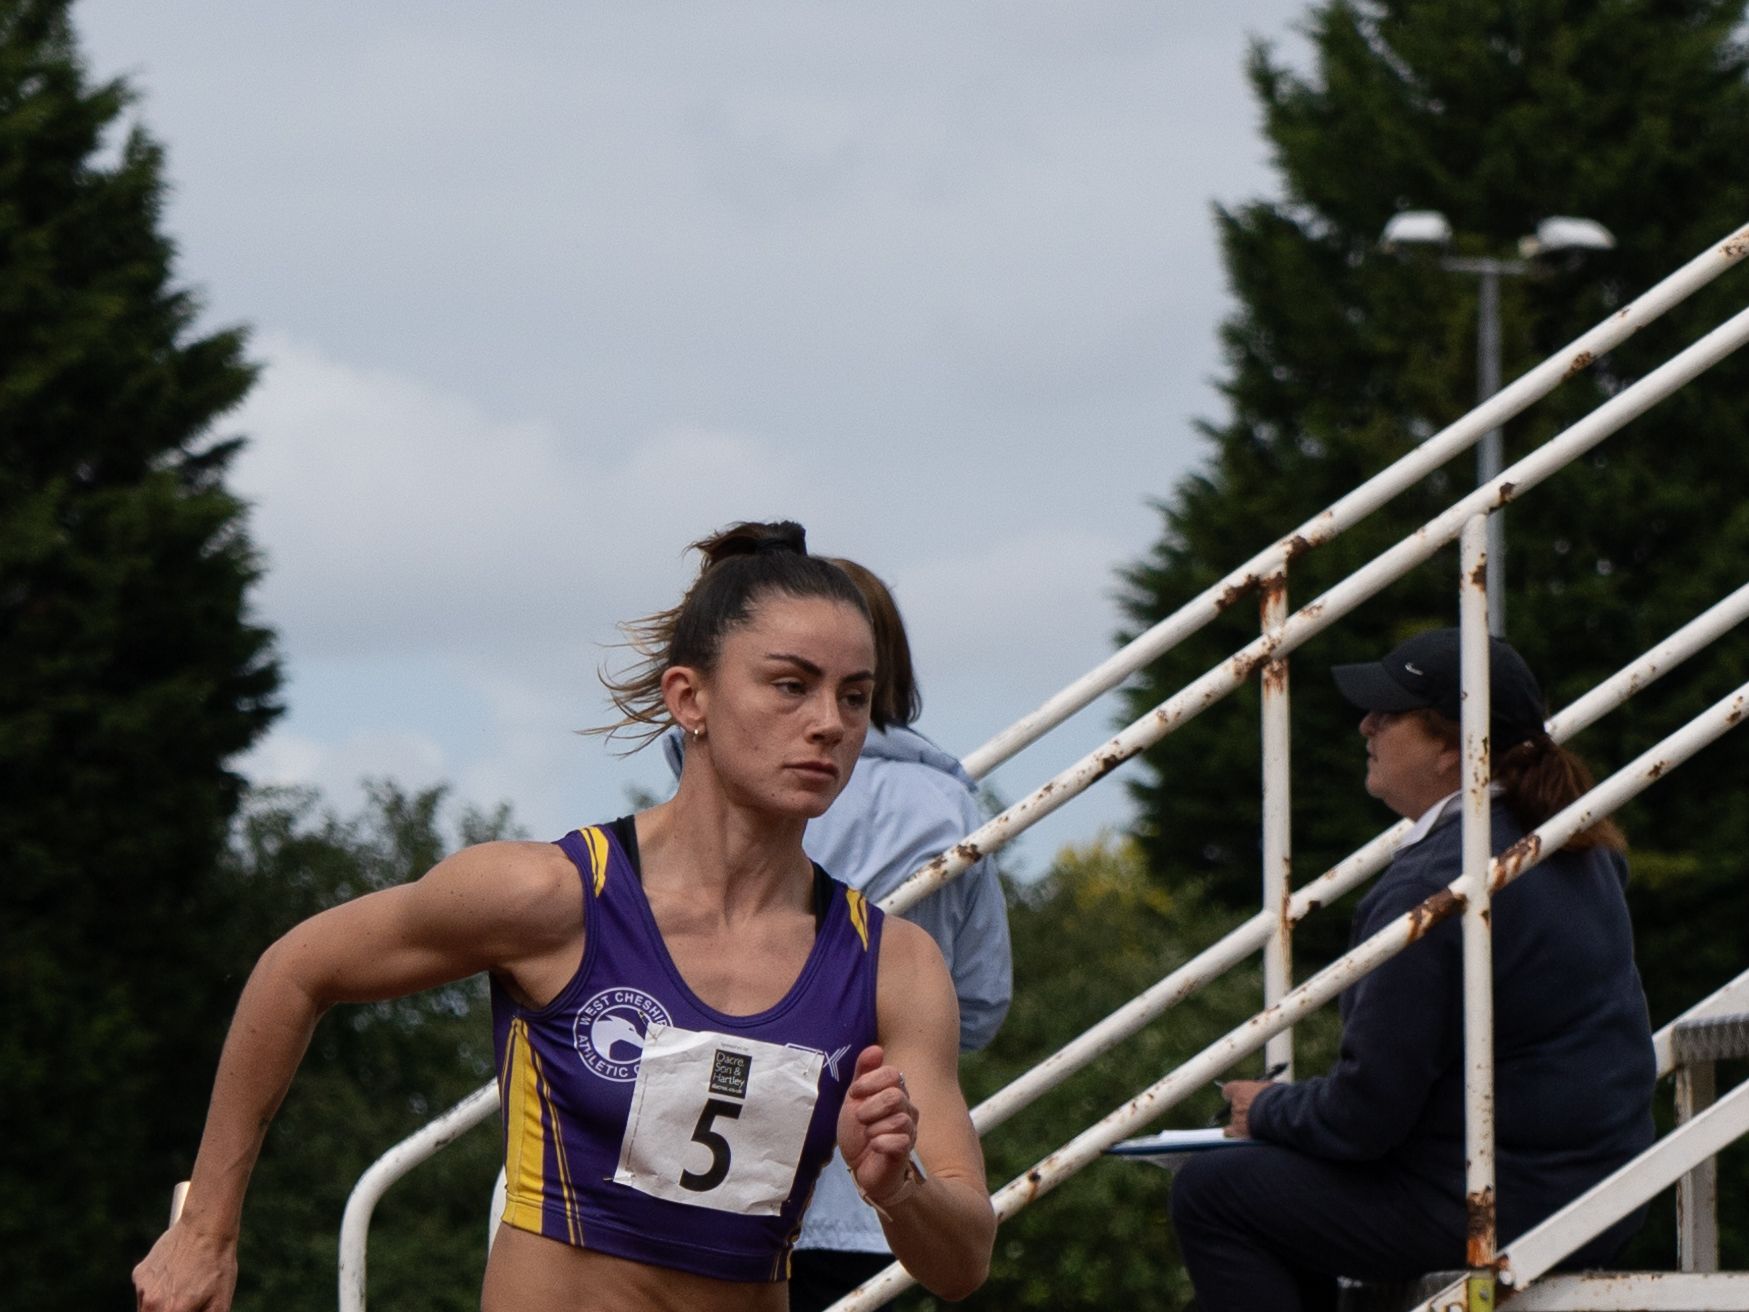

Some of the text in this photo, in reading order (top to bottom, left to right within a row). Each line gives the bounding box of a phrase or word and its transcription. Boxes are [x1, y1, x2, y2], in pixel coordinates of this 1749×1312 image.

[579, 992, 668, 1027] WEST CHESHI
[578, 1034, 628, 1078] ATHLETIC
[715, 1062, 742, 1076] Son &
[713, 1072, 746, 1088] Hartley
[679, 1098, 743, 1192] 5
